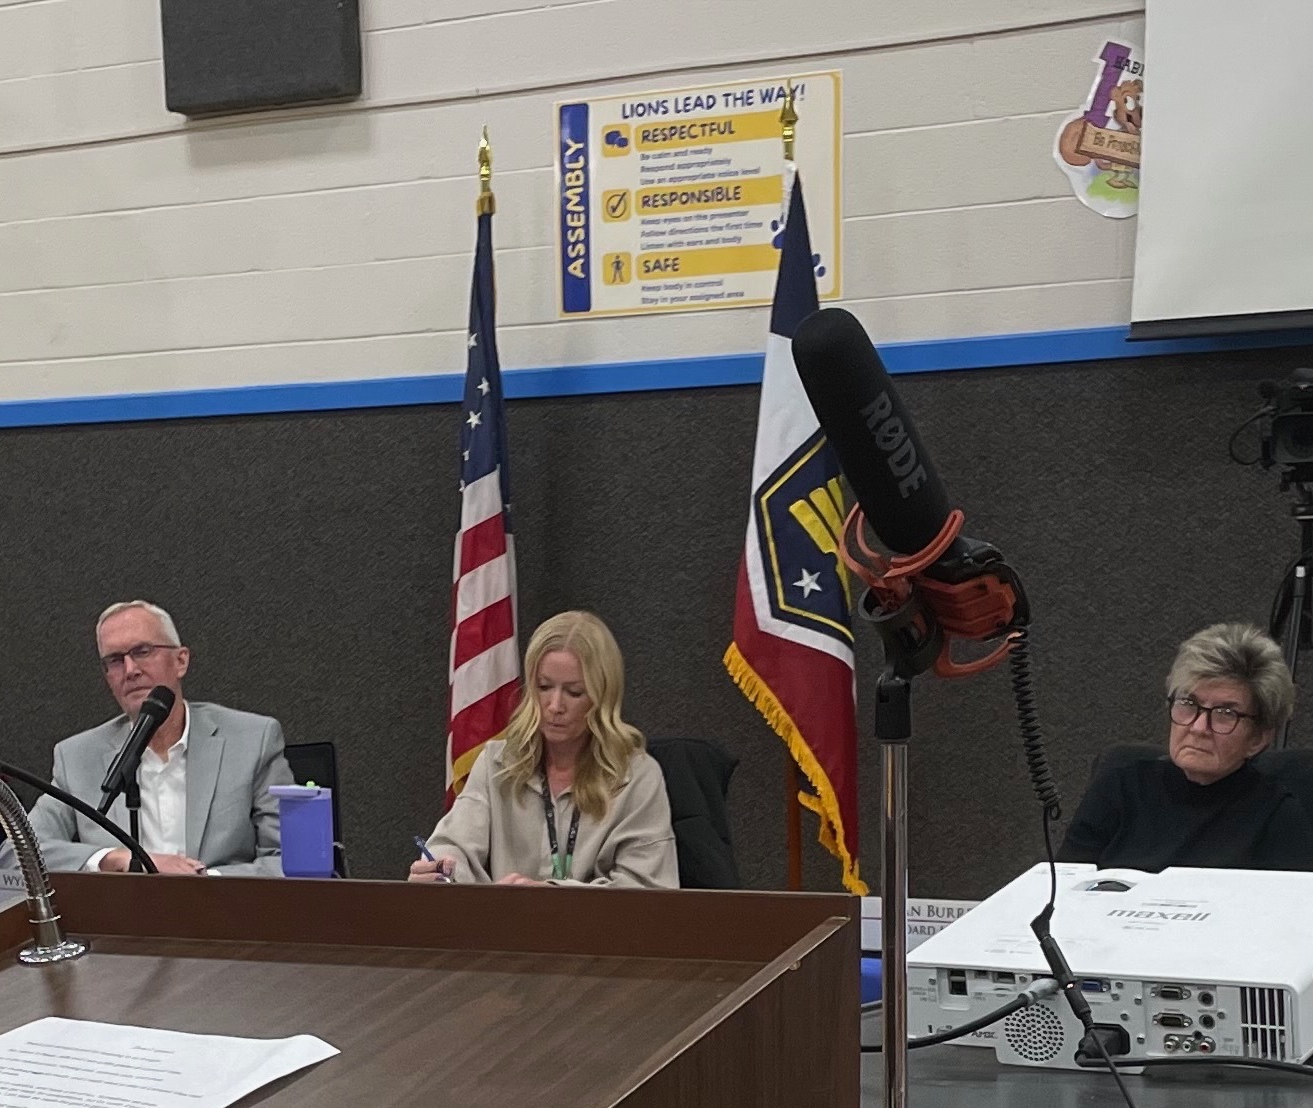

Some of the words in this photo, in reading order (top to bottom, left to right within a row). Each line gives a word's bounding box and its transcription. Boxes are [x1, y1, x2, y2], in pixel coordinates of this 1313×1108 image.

[1113, 55, 1145, 76] HABI
[622, 100, 668, 119] LIONS
[674, 94, 716, 114] LEAD
[722, 89, 754, 108] THE
[759, 83, 806, 104] WAY!
[642, 120, 735, 144] RESPECTFUL
[641, 185, 742, 208] RESPONSIBLE
[566, 138, 585, 279] ASSEMBLY
[642, 257, 680, 274] SAFE
[1107, 909, 1211, 921] maxell
